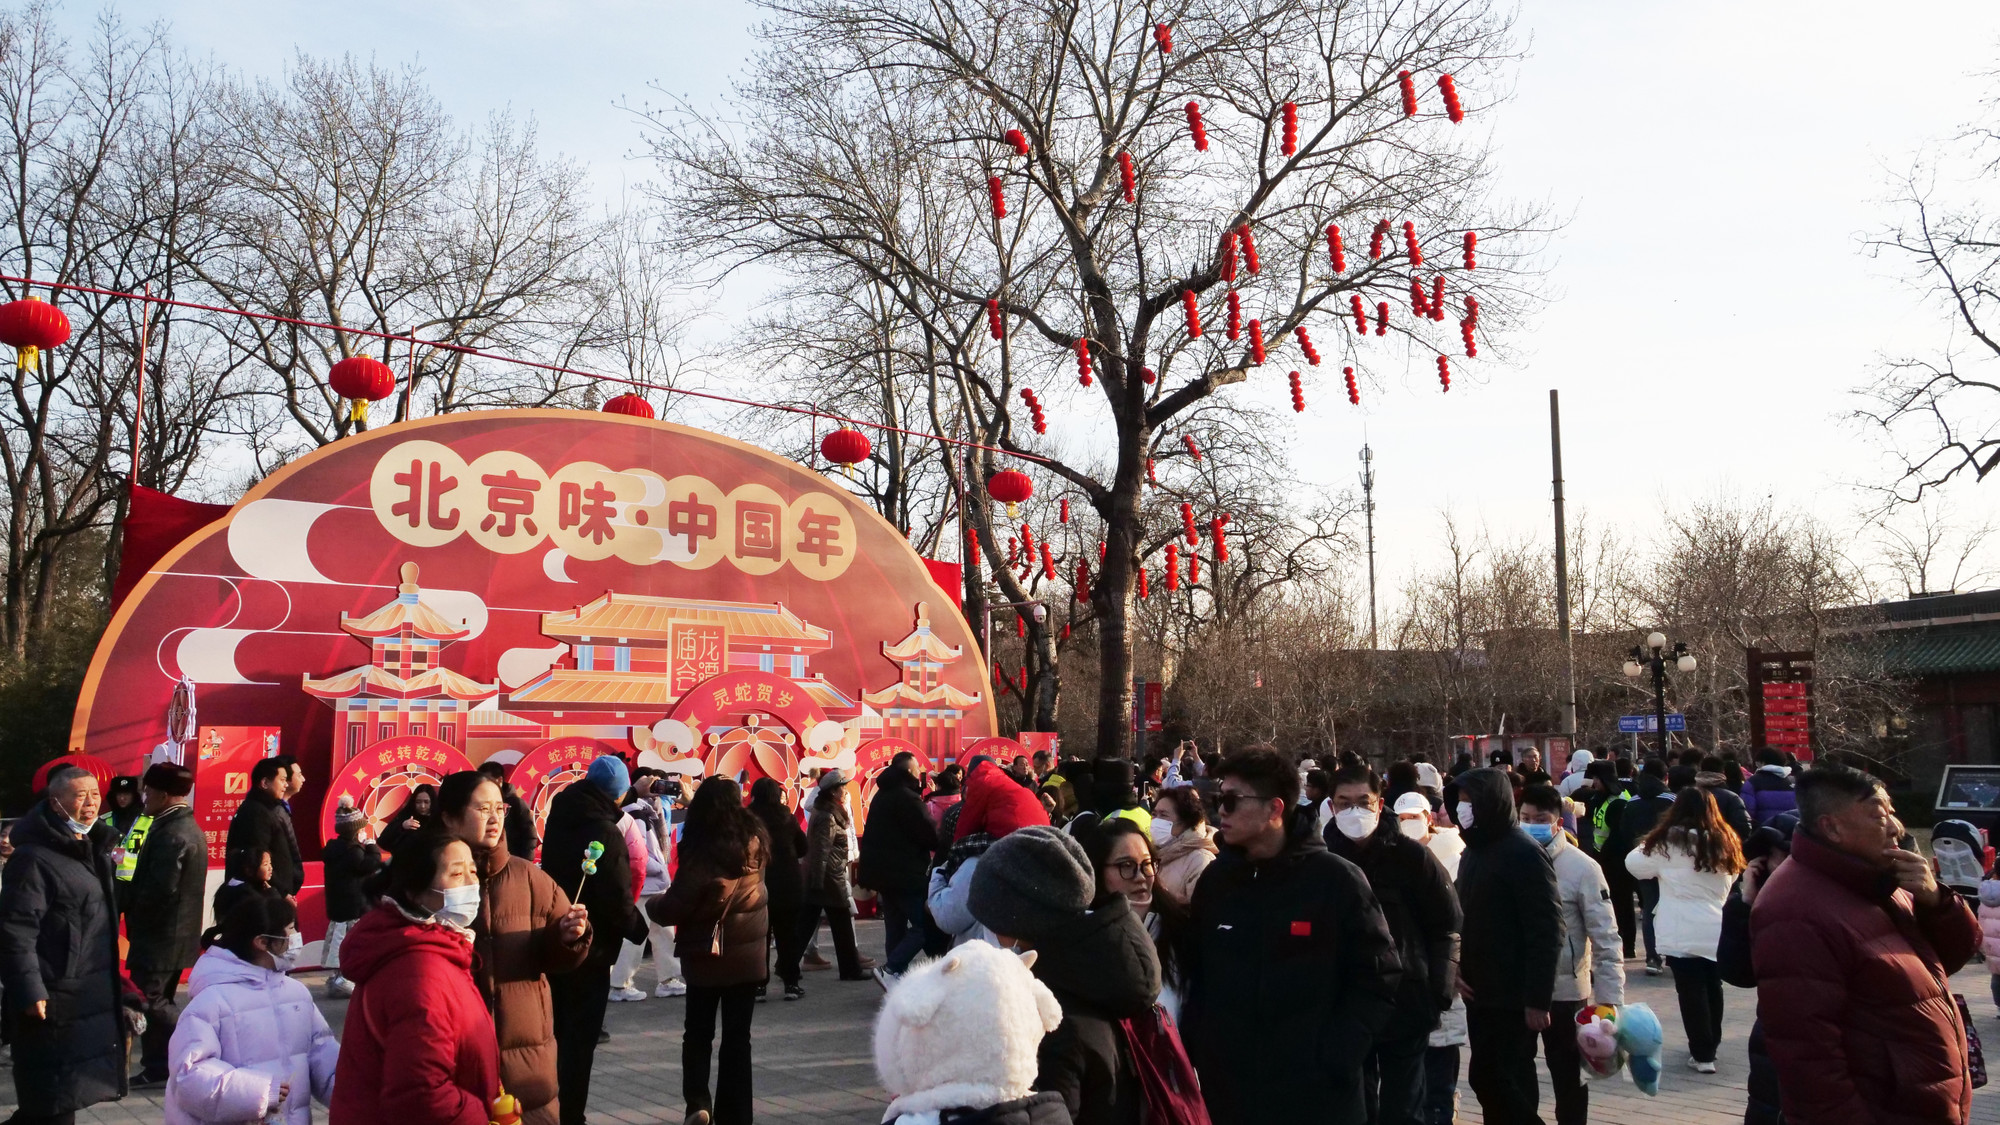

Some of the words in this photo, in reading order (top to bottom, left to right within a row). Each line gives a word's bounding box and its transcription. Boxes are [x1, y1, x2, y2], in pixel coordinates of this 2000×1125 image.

[391, 458, 844, 567] 北京味·中国年
[712, 682, 794, 711] 灵蛇贺岁
[378, 744, 448, 767] 蛇转乾坤
[870, 745, 912, 761] 蛇舞新
